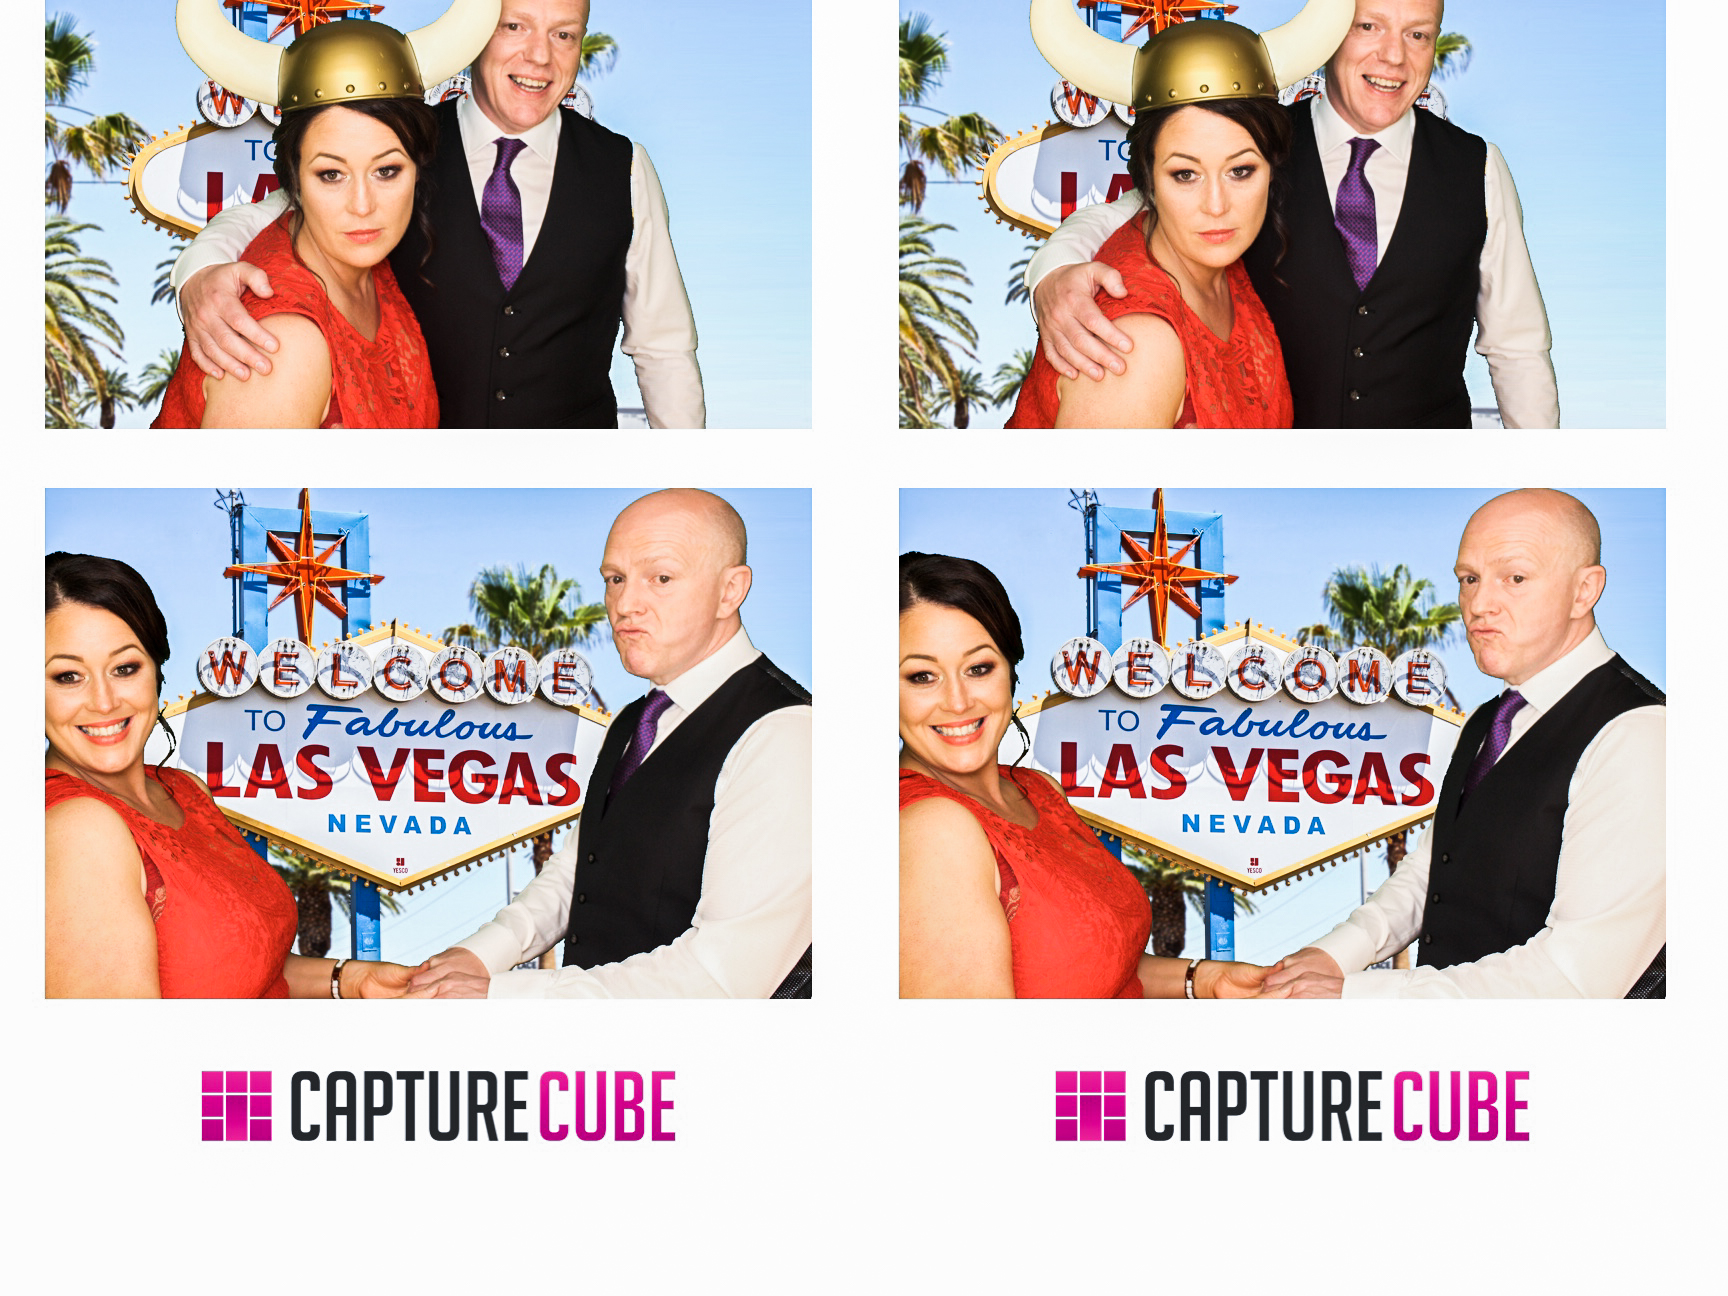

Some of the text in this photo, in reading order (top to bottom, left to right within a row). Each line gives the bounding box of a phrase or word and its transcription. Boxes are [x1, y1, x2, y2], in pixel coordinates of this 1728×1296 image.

[207, 650, 577, 695] WELCOME
[1061, 650, 1431, 695] WELCOME
[244, 703, 534, 741] TO Fabulous
[1098, 703, 1388, 741] TO Fabulous
[206, 741, 581, 807] LAS VEGAS
[1060, 741, 1435, 807] LAS VEGAS
[328, 814, 472, 835] NEVADA
[1182, 814, 1326, 835] NEVADA
